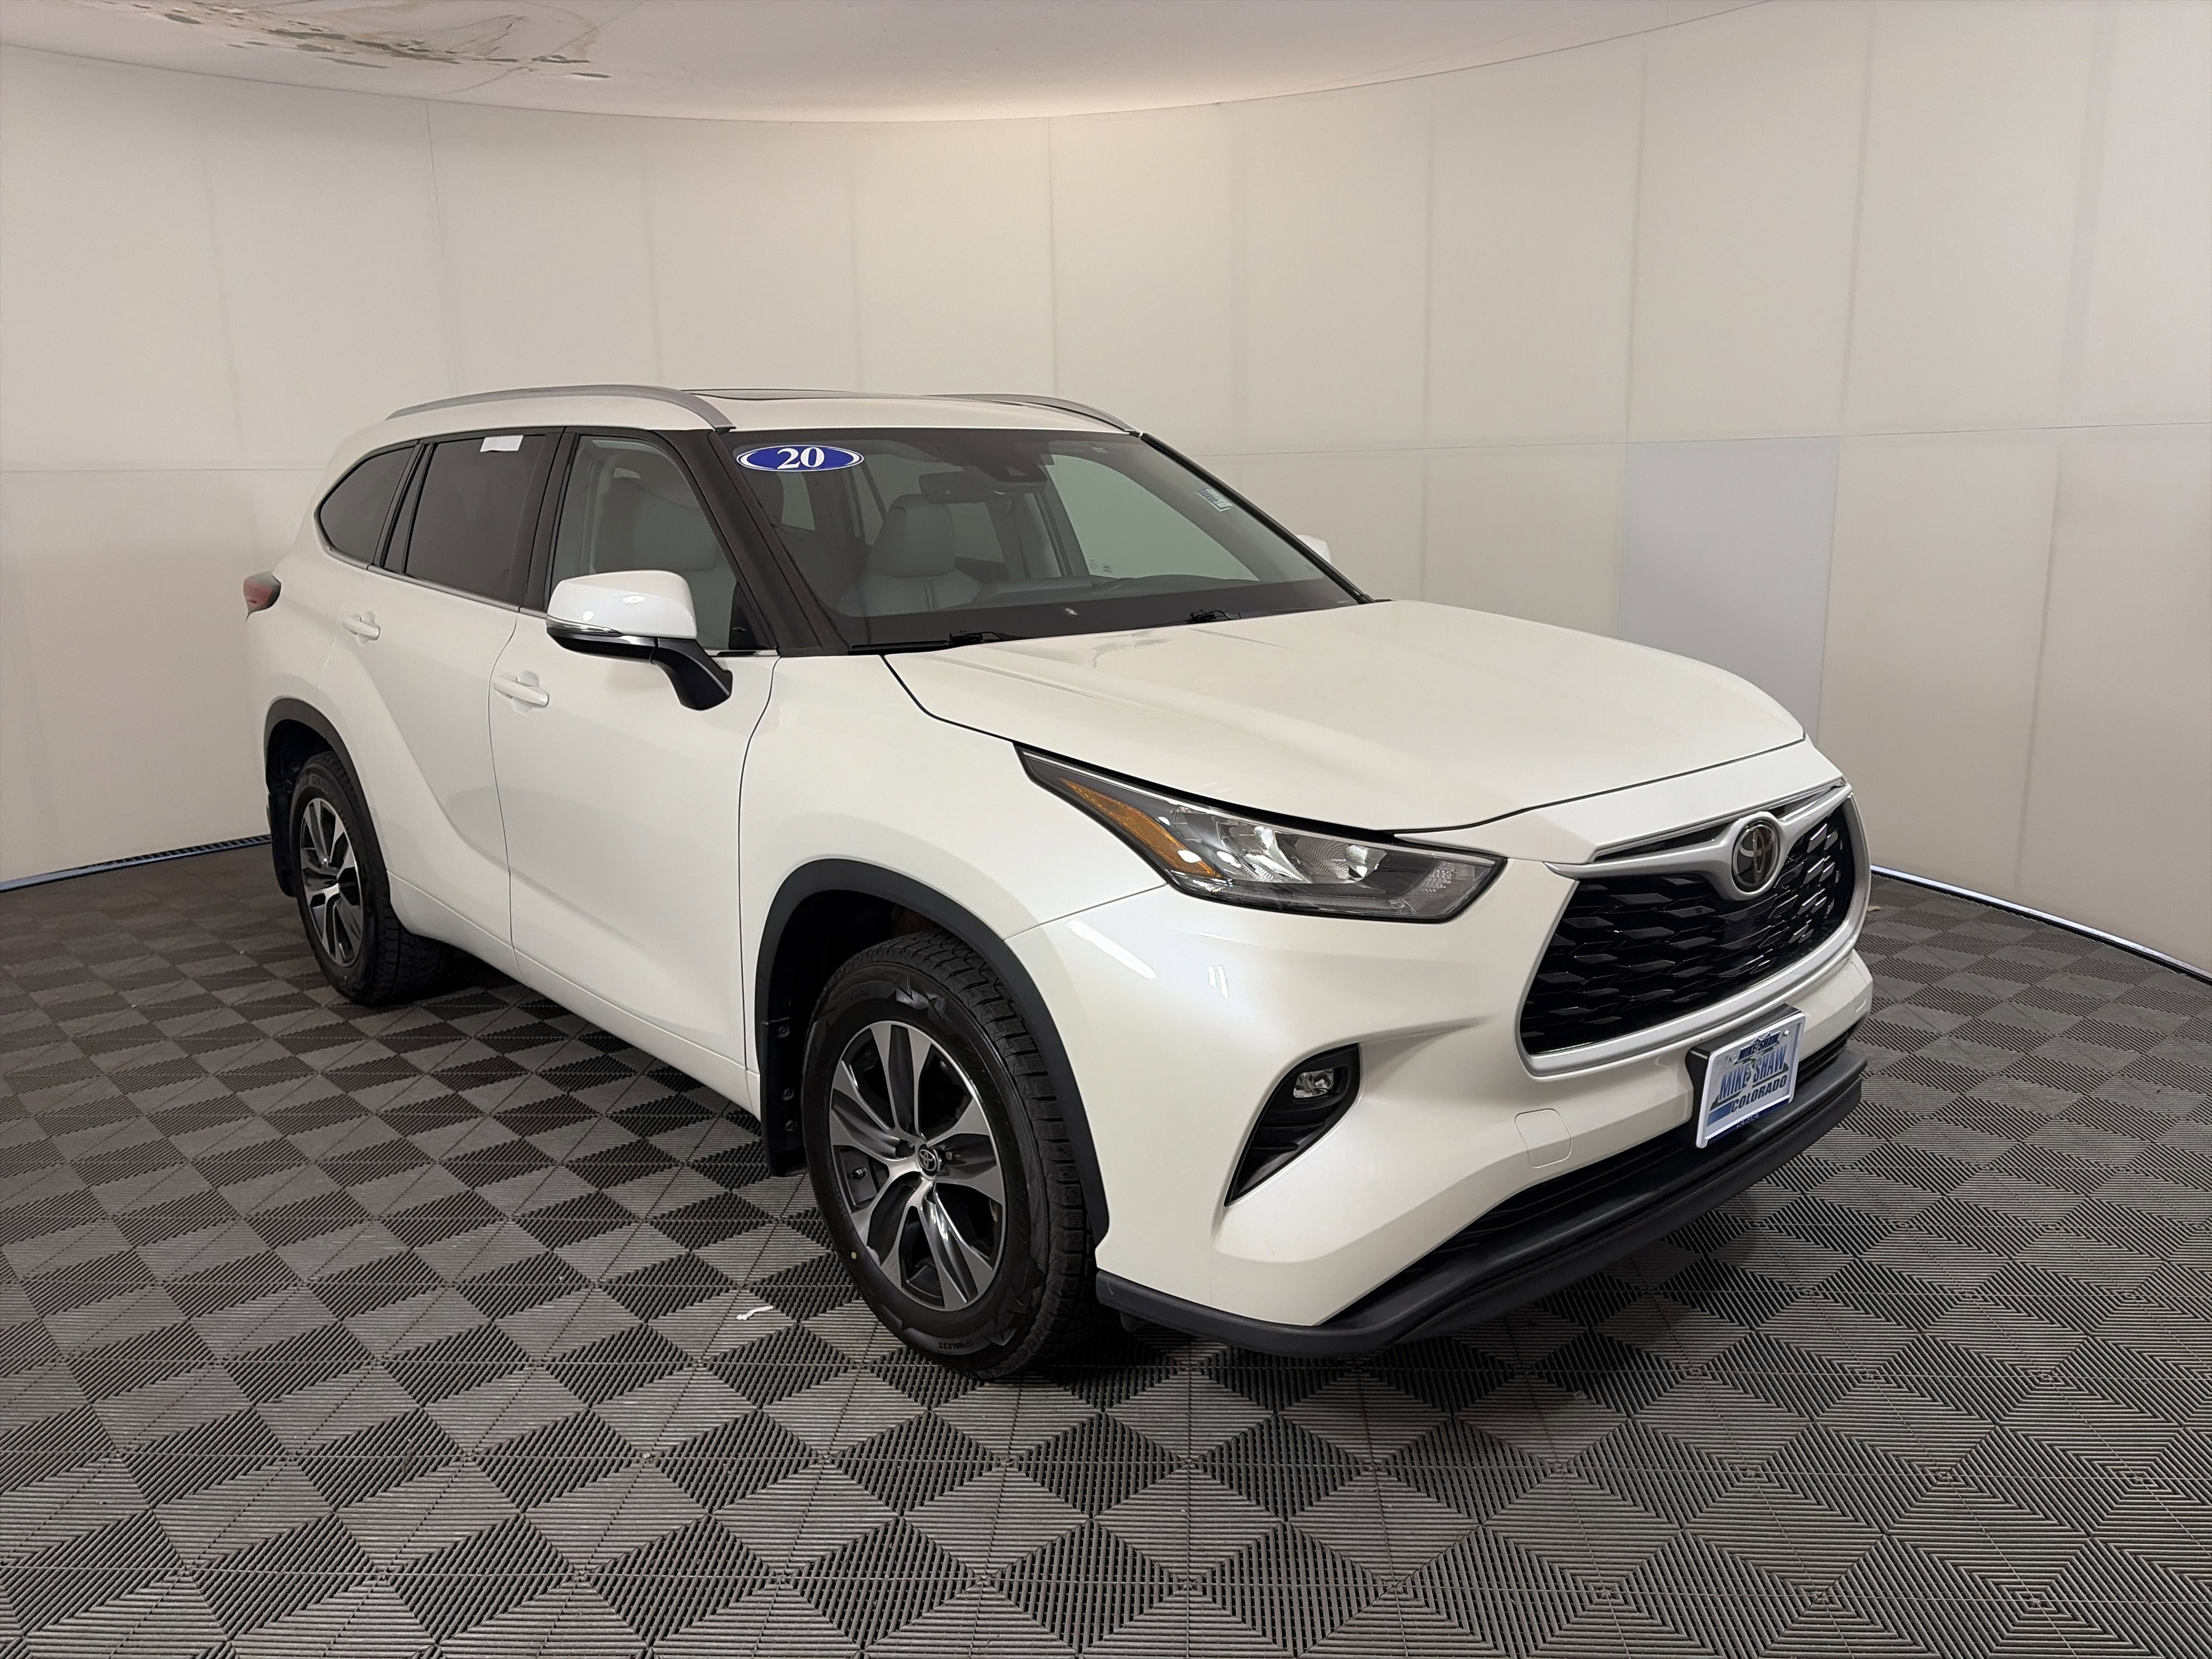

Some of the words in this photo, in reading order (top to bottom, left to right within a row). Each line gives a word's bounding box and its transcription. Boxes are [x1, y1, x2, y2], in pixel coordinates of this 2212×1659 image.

[777, 447, 825, 470] 20
[1718, 1065, 1751, 1101] MIKE
[1753, 1045, 1787, 1083] SHAW
[1730, 1075, 1787, 1113] COLORADO
